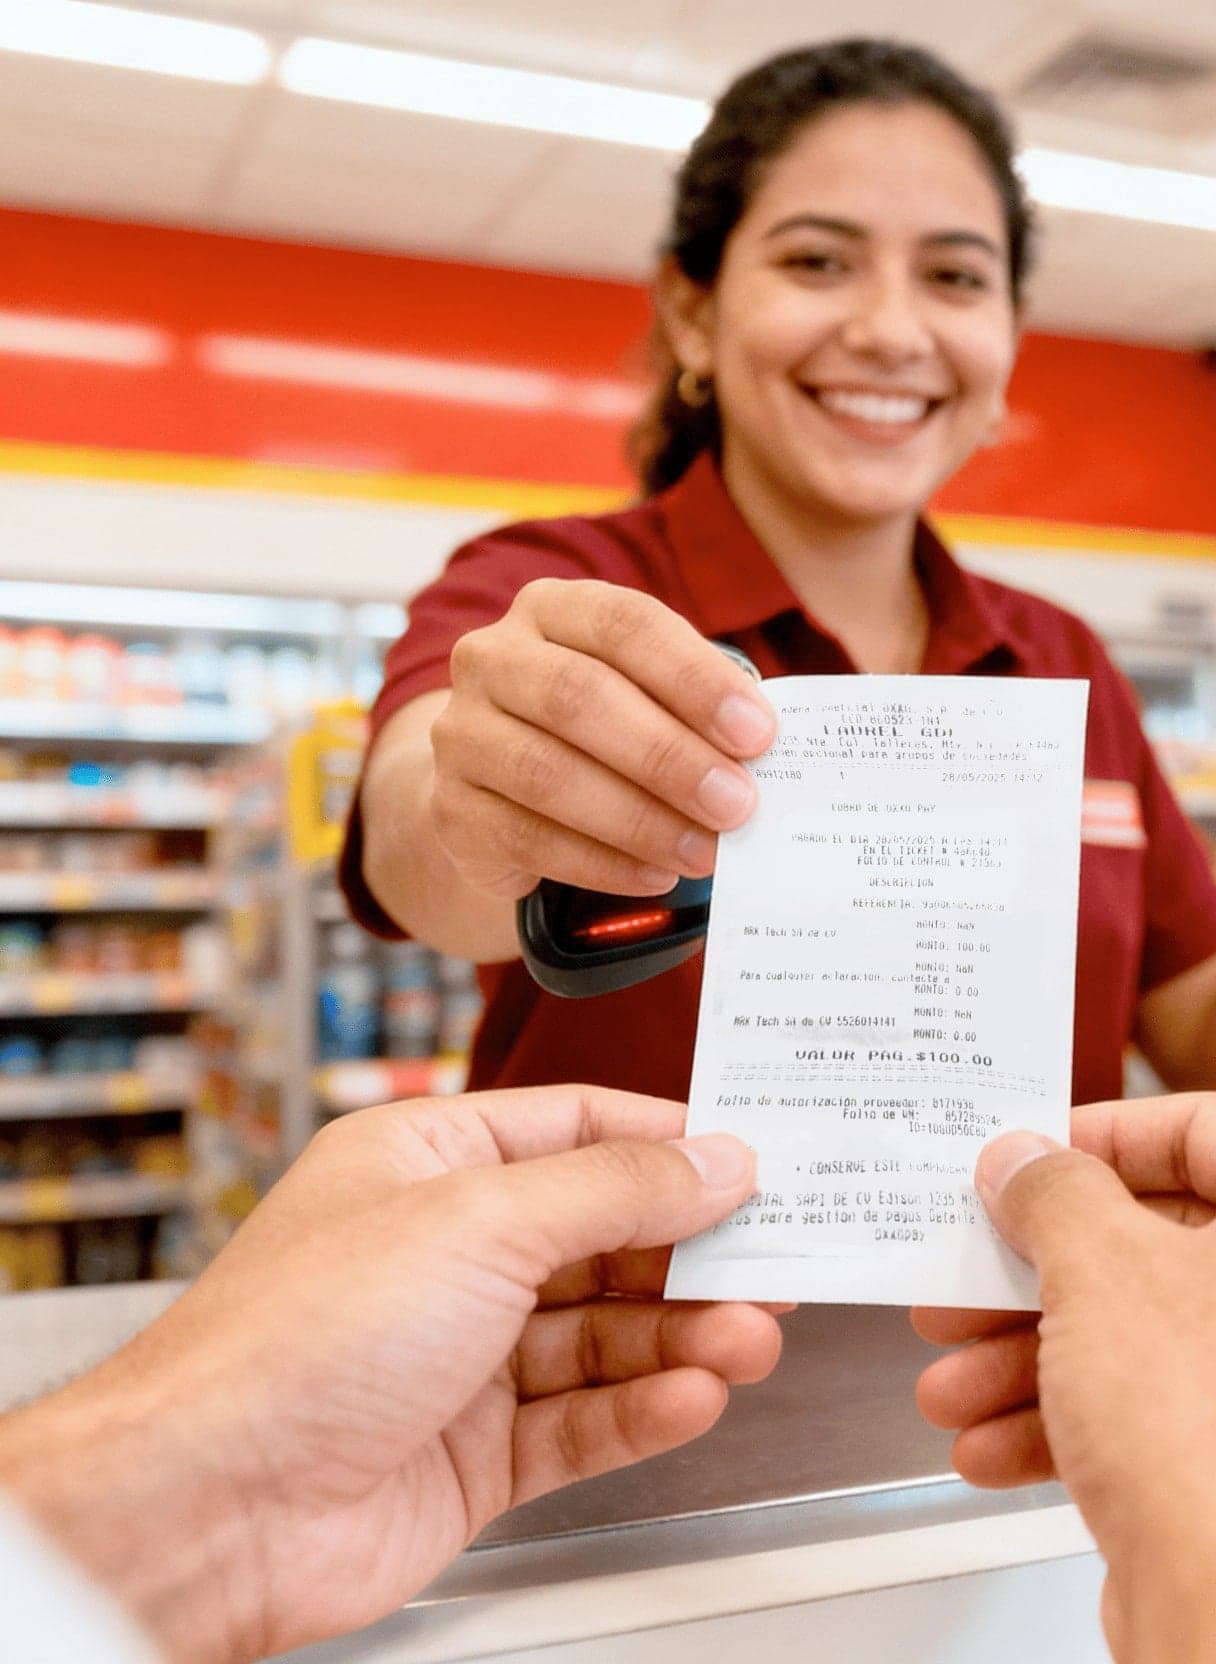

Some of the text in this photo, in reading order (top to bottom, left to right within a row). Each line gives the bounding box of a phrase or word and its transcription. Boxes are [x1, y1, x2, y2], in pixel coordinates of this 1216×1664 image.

[823, 725, 903, 737] LAUREL
[803, 748, 854, 760] opcional
[860, 751, 888, 761] para
[895, 751, 936, 762] grupos
[942, 750, 956, 761] de
[867, 803, 879, 813] DE
[832, 834, 843, 845] EL
[863, 845, 876, 855] EN
[880, 845, 892, 856] EL
[899, 845, 936, 857] TICKET
[857, 855, 888, 867] FOLIO
[893, 856, 905, 867] DE
[915, 962, 950, 974] MONTO:
[740, 969, 761, 981] Para
[914, 983, 949, 996] MONTO:
[914, 1006, 948, 1018] MONTO:
[756, 1015, 781, 1027] Tech
[818, 1016, 832, 1028] CV
[836, 1015, 897, 1028] 5526014141
[912, 1028, 978, 1043] MONTO: 0.00
[795, 1049, 856, 1062] VALOR
[716, 1095, 752, 1107] Folio
[863, 1098, 926, 1110] proveedor:
[843, 1108, 877, 1120] Folio
[883, 1110, 897, 1120] de
[808, 1159, 867, 1176] CONSERVE
[874, 1159, 901, 1173] ESTE
[795, 1192, 825, 1207] SAPI
[833, 1192, 849, 1207] DE
[855, 1191, 872, 1205] CV
[760, 1212, 793, 1225] para
[863, 1210, 879, 1223] de
[886, 1210, 922, 1224] pagos
